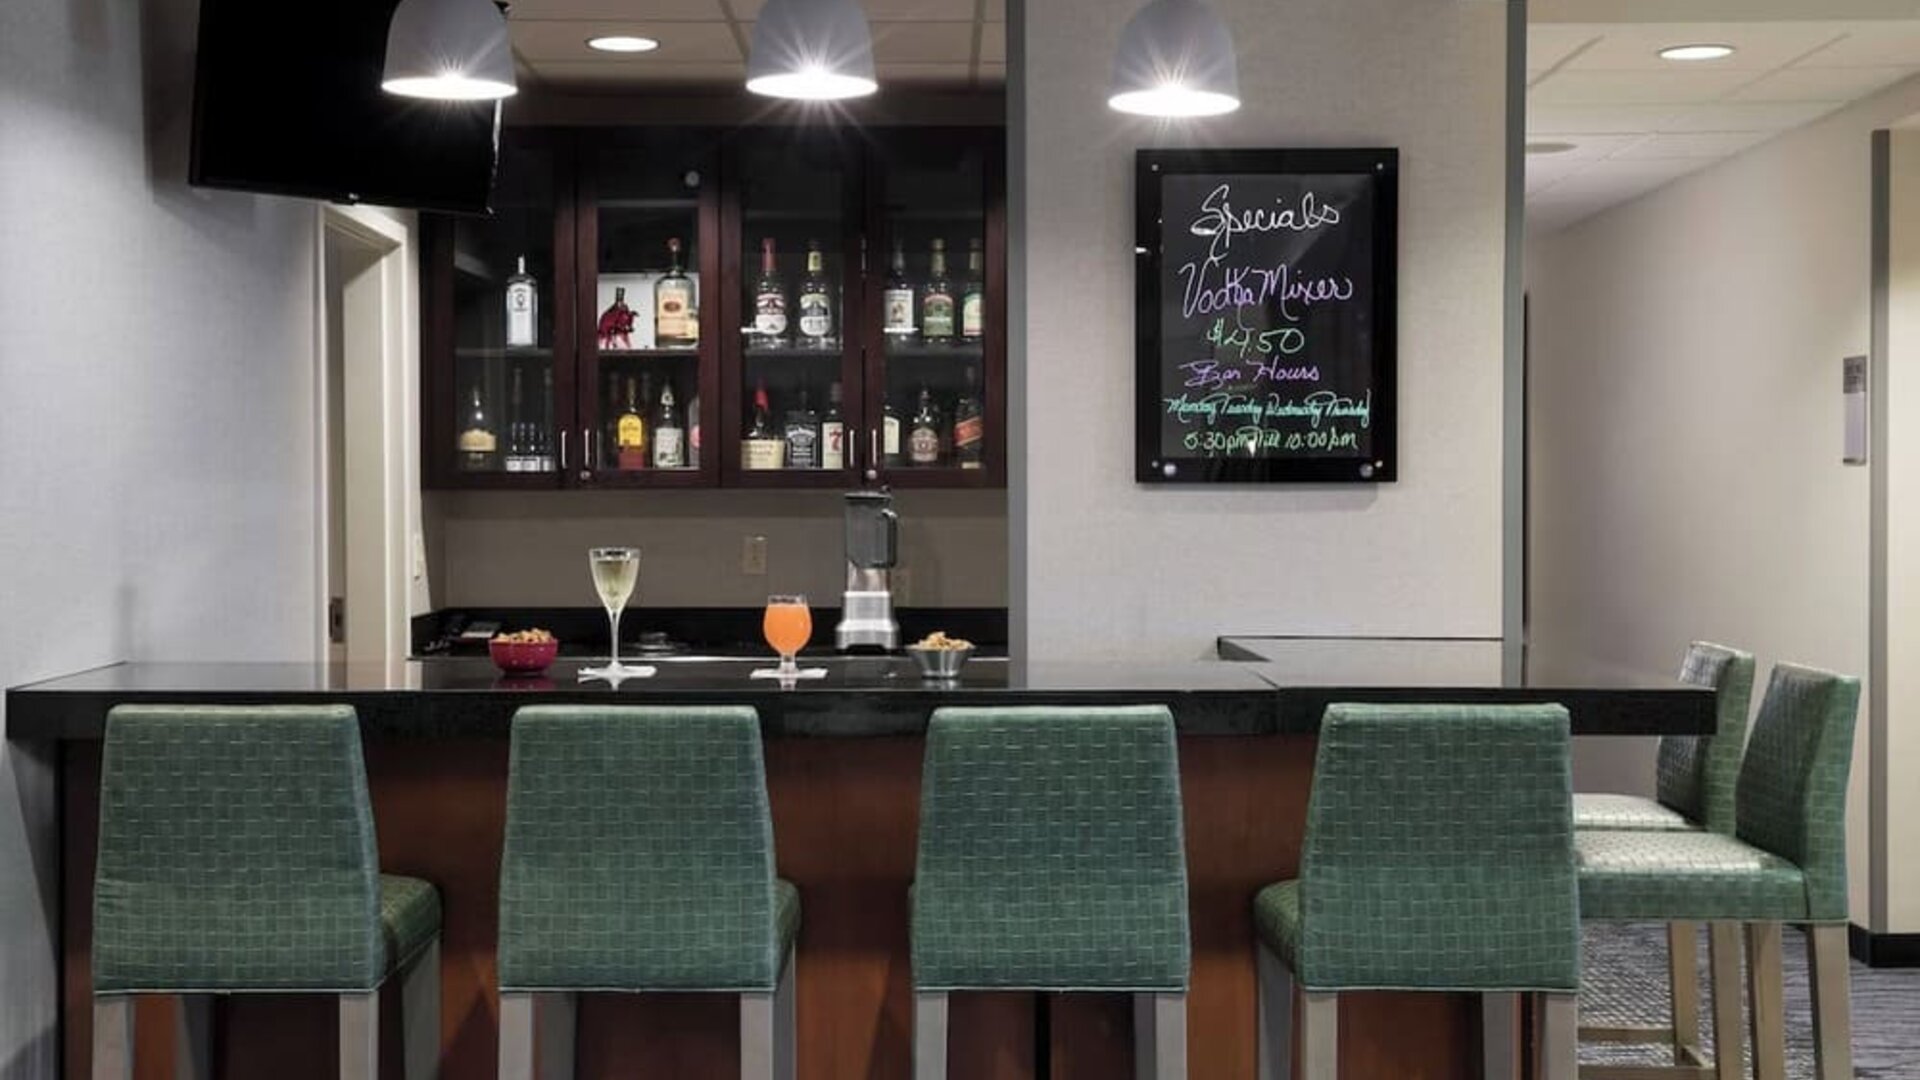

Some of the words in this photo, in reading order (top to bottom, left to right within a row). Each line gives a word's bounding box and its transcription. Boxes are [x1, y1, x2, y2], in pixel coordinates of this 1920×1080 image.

[1190, 184, 1340, 249] Specials
[1178, 252, 1256, 327] Vodka
[1251, 264, 1353, 321] Mixer
[1206, 319, 1305, 357] $4.50
[1246, 355, 1320, 382] Hours
